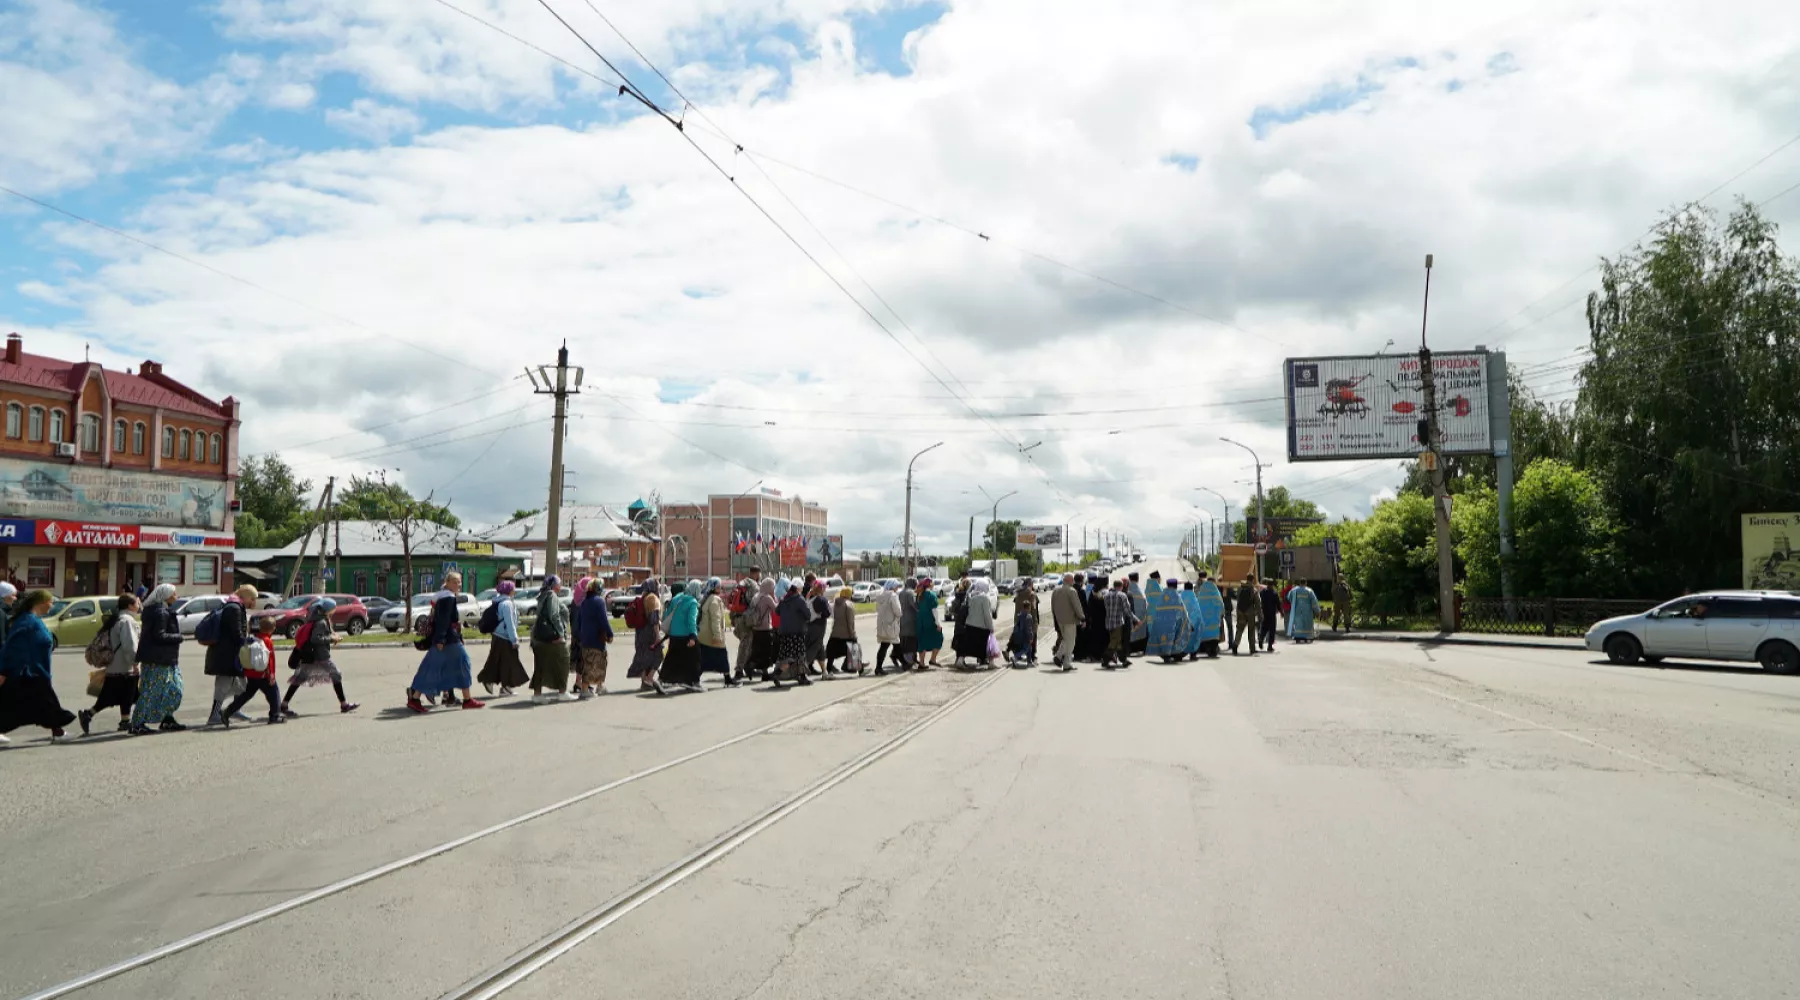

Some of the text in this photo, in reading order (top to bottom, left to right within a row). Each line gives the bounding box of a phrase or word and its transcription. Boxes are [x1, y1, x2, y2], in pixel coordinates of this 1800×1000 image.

[1433, 359, 1479, 368] ПРОДАЖ
[146, 494, 167, 505] ГОД
[64, 530, 135, 546] АЛТАМАР
